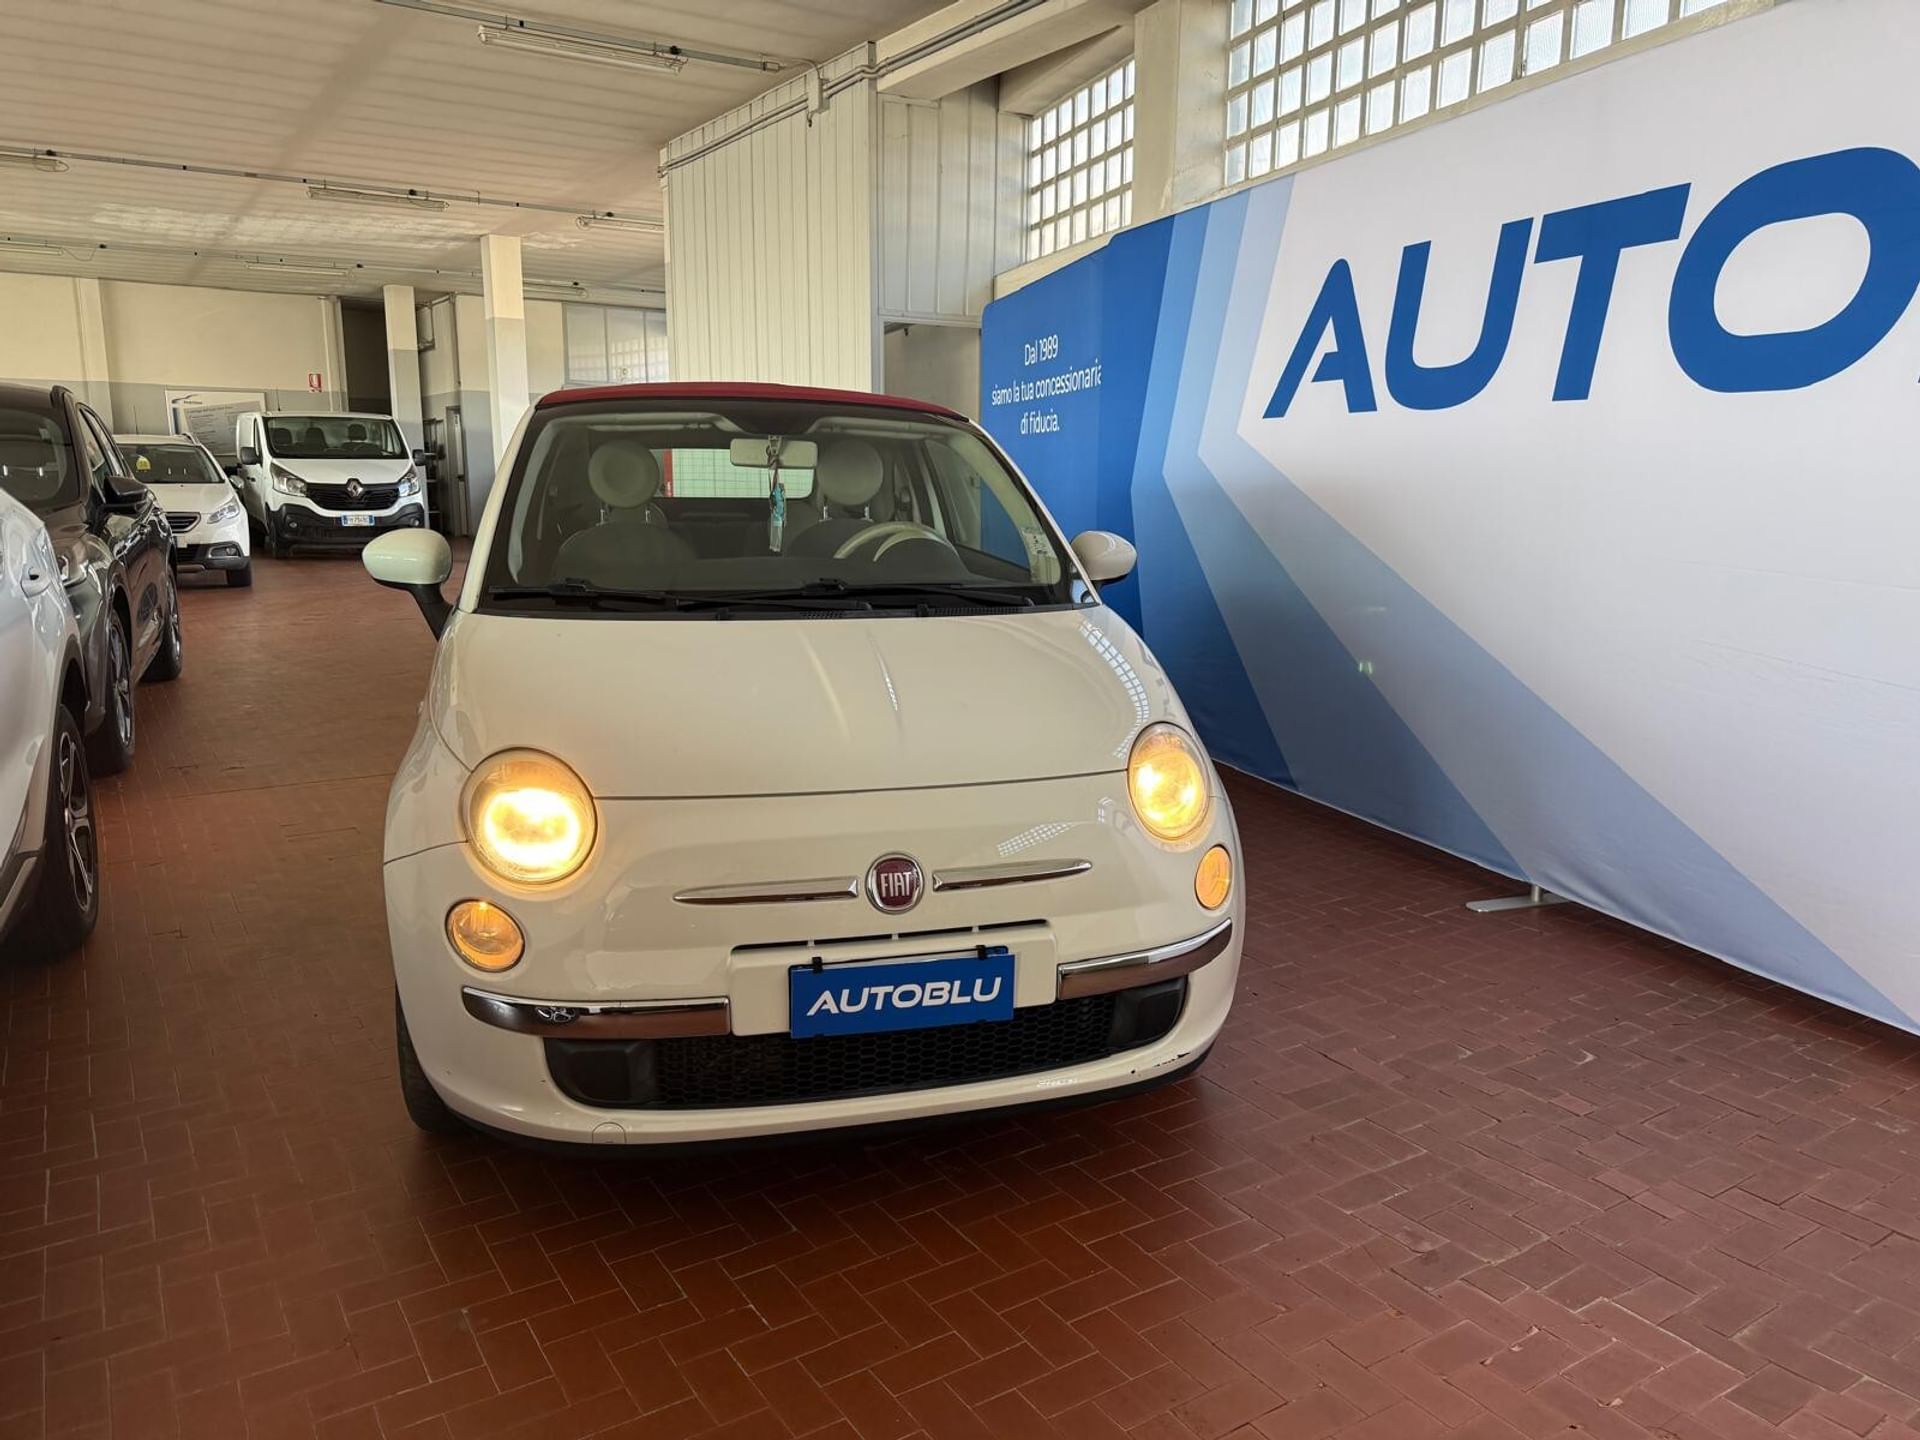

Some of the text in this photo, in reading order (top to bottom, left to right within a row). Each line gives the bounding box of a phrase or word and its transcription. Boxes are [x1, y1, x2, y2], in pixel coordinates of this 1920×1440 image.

[1262, 147, 1920, 419] AUTO
[1024, 334, 1059, 366] Dal 1989
[991, 358, 1102, 406] siamo la tua concessionaria
[1020, 408, 1060, 435] di fiducia.
[879, 871, 913, 898] FIAT
[806, 976, 1002, 1017] AUTOBLU
